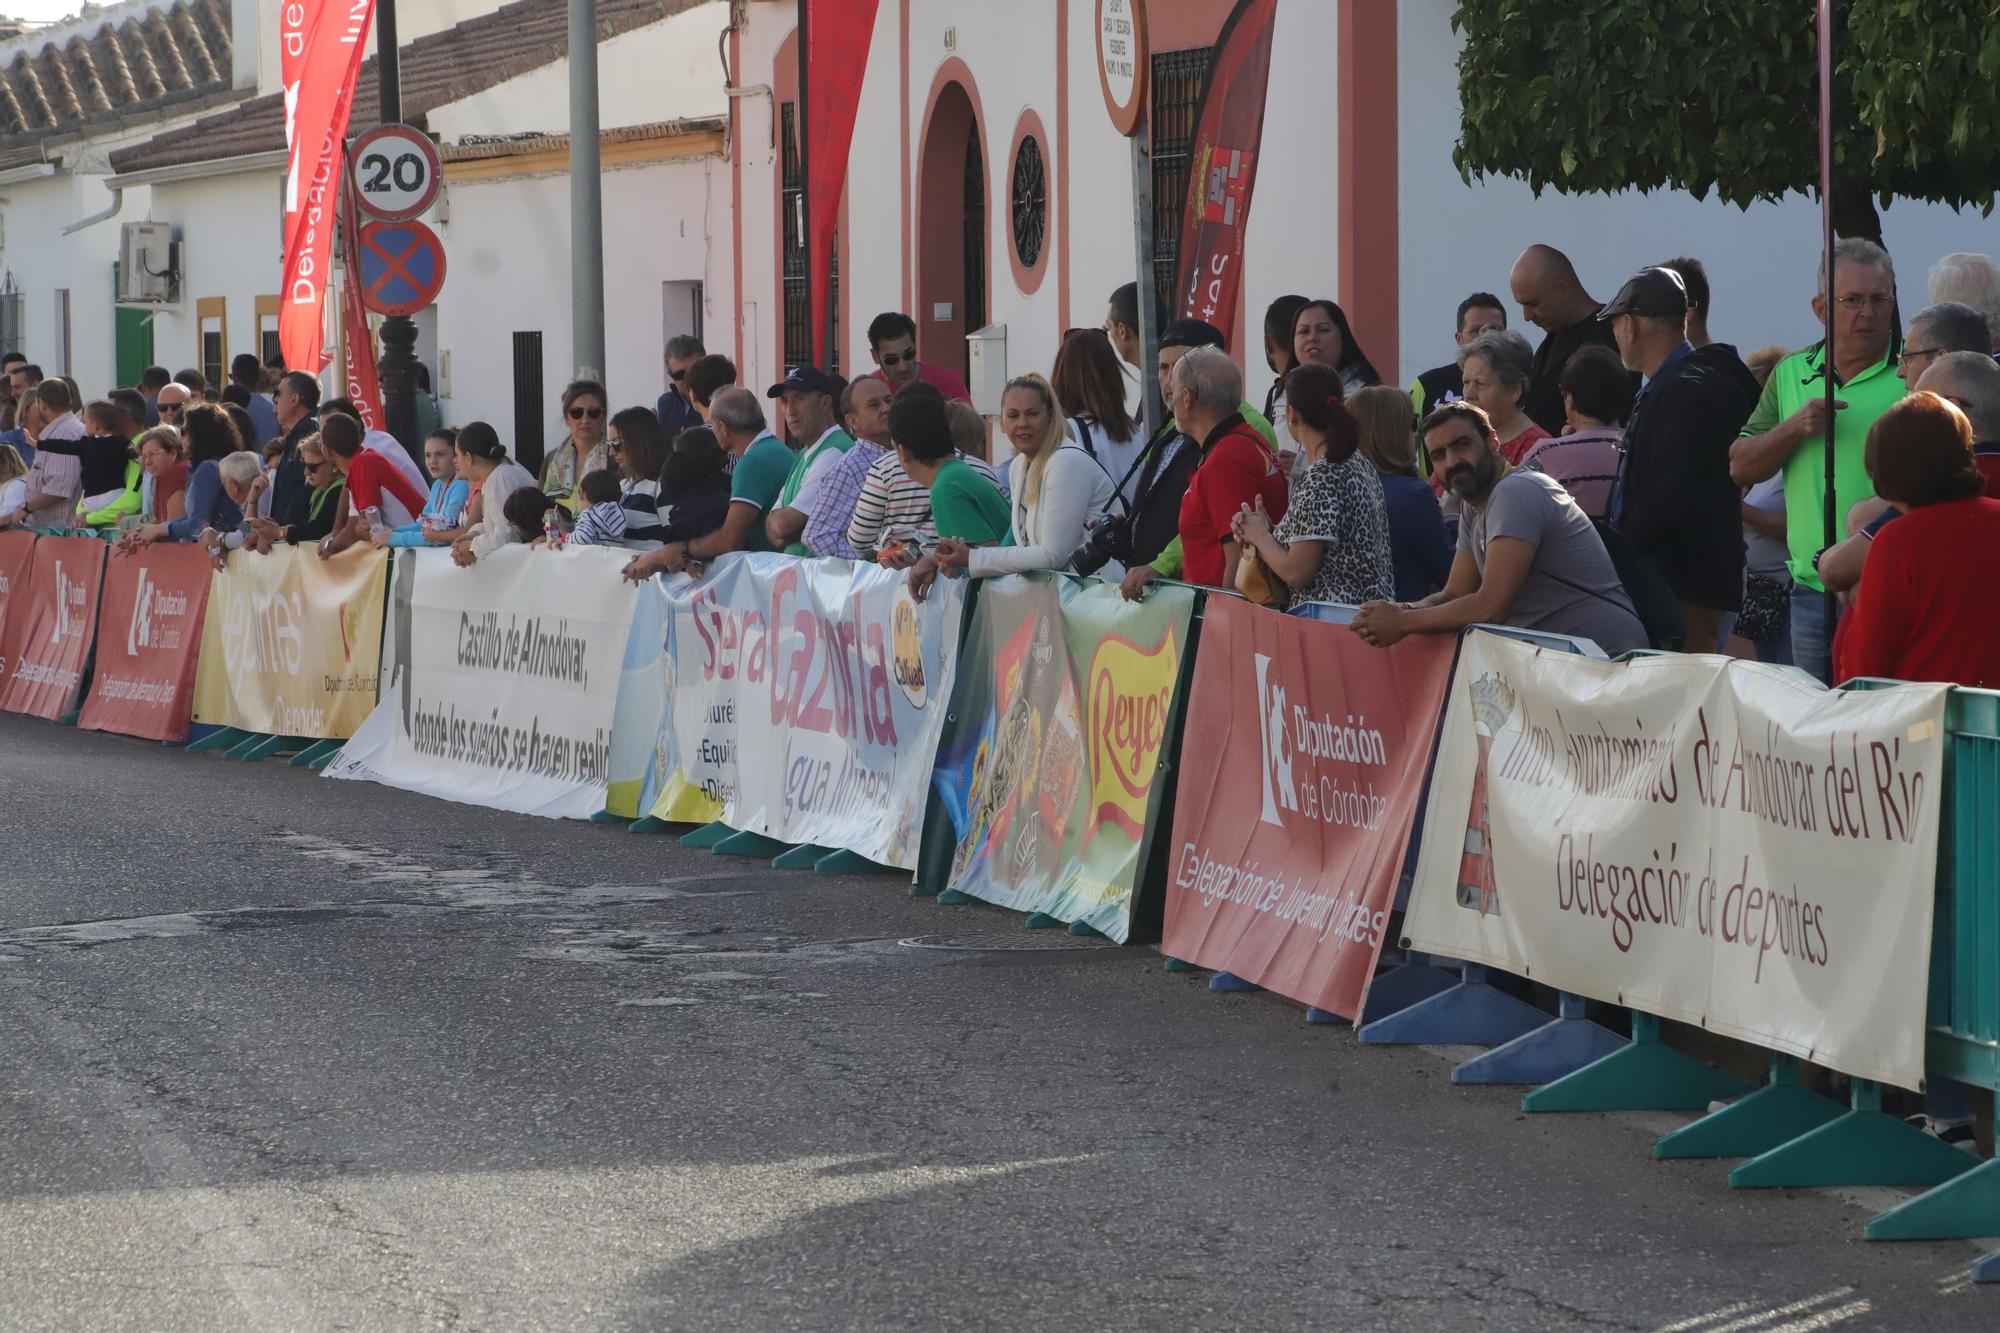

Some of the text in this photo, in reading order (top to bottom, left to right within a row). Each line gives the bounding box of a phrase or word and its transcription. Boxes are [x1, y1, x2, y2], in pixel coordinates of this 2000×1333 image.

[361, 152, 426, 193] 20
[457, 611, 588, 691] Castillo de Almodóvar,
[770, 566, 898, 747] Cazorla
[413, 697, 448, 757] donde
[448, 703, 467, 760] los
[507, 728, 528, 772] se
[1293, 704, 1387, 767] Diputación
[1301, 772, 1386, 831] de Córdoba
[1693, 706, 1720, 808] de
[1824, 730, 1870, 839] del
[1870, 736, 1924, 844] Río
[1175, 841, 1265, 907] Delegación
[1255, 871, 1285, 912] de
[1557, 832, 1828, 985] Delegación de deportes
